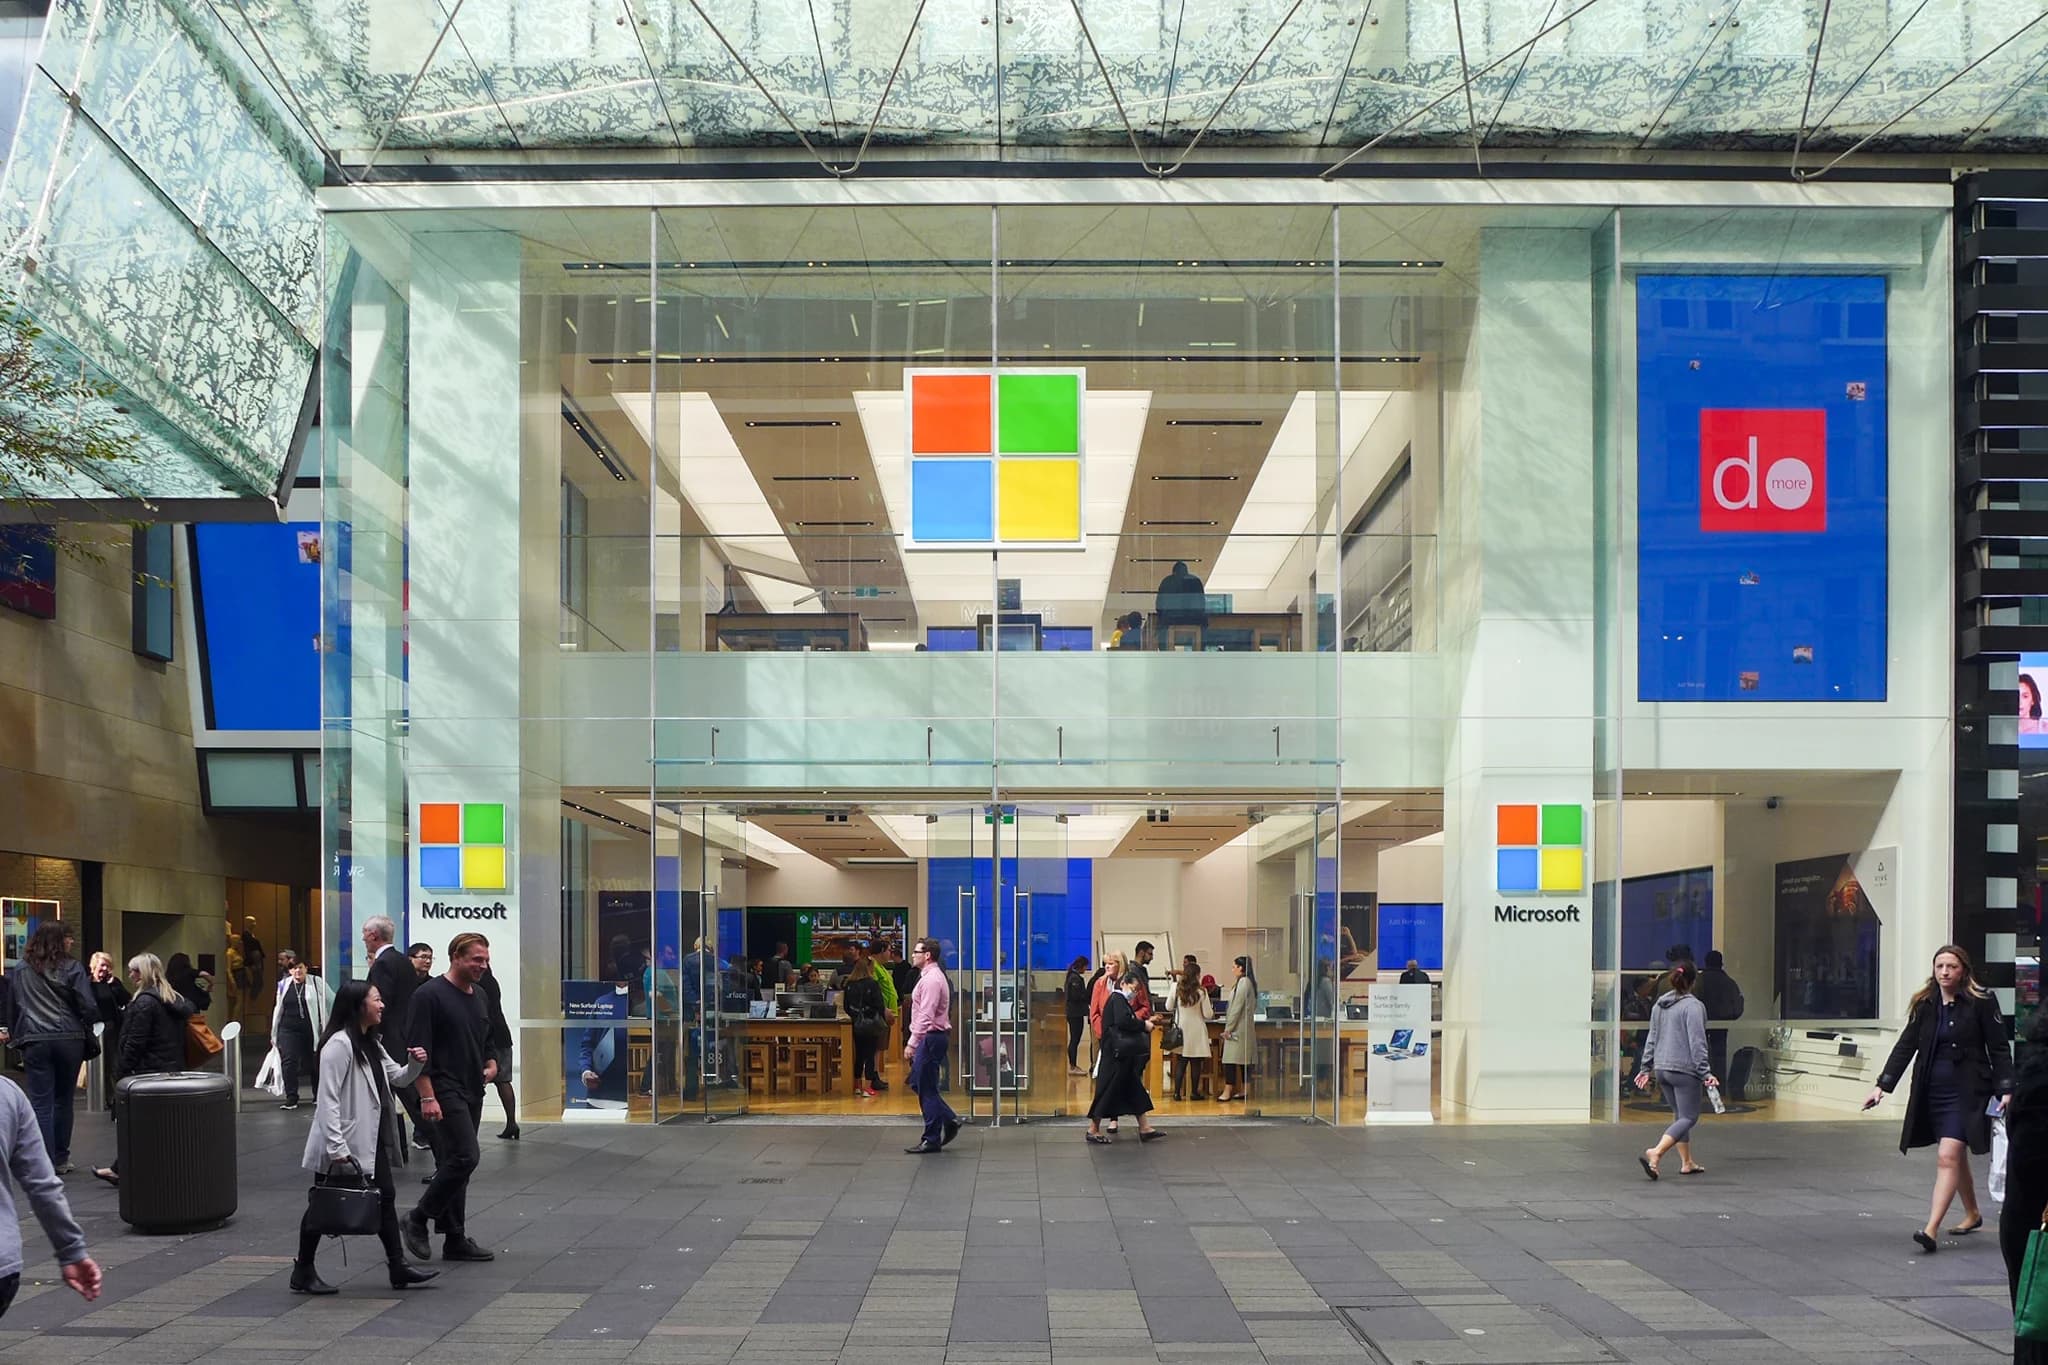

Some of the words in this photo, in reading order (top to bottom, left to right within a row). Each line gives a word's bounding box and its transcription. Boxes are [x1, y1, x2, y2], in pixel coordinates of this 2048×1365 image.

[1771, 479, 1808, 490] more
[421, 901, 507, 920] Microsoft
[1494, 904, 1581, 922] Microsoft
